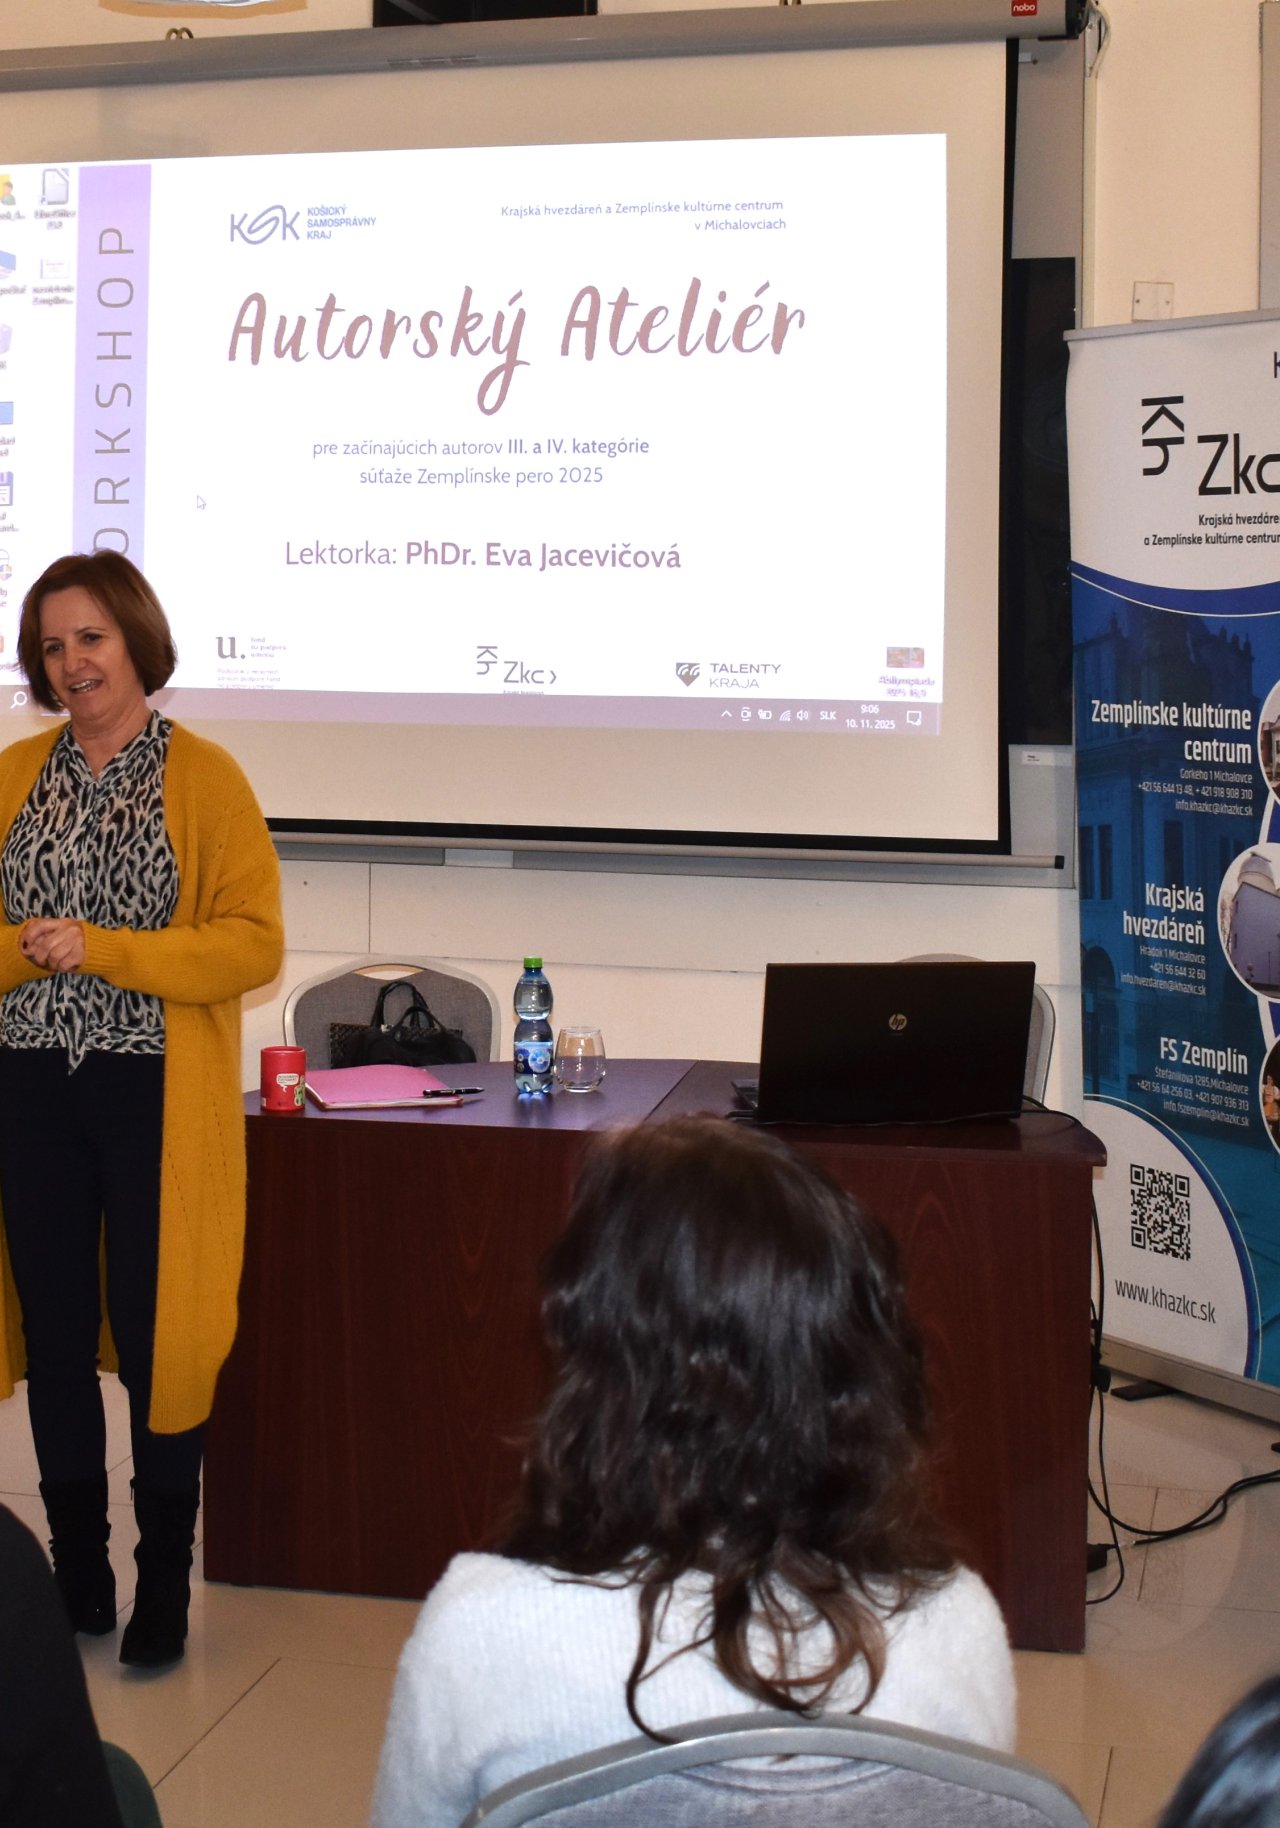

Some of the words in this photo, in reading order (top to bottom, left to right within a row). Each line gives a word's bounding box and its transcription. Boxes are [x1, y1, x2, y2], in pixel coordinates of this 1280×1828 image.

[1012, 4, 1036, 12] nobo
[306, 205, 347, 217] KOŠICKÝ
[501, 205, 541, 219] Krajská
[544, 203, 602, 216] hvezdáreň
[605, 206, 612, 215] a
[615, 201, 681, 216] Zemplínske
[683, 200, 733, 213] kultúrne
[734, 200, 784, 211] centrum
[306, 215, 377, 229] SAMOSPRÁVNY
[694, 222, 701, 231] v
[704, 218, 787, 231] Michalovciach
[306, 230, 332, 241] KRAJ
[228, 285, 531, 416] Autorský
[561, 276, 806, 361] Ateliér
[92, 227, 135, 554] ORKSHOP
[312, 444, 338, 459] pre
[343, 438, 438, 461] začínajúcich
[441, 441, 503, 456] autorov
[508, 438, 528, 456] III.
[533, 443, 542, 455] a
[547, 438, 568, 455] IV.
[572, 437, 650, 459] kategórie
[1197, 432, 1280, 496] Zkc
[360, 467, 413, 485] súťaže
[417, 466, 511, 489] Zemplínske
[516, 471, 554, 488] pero
[559, 467, 604, 484] 2025
[1198, 512, 1233, 528] Krajská
[1235, 511, 1280, 525] hvezdáre
[1143, 537, 1150, 546] a
[1151, 532, 1203, 548] Zemplínske
[1205, 532, 1244, 545] kultúrne
[285, 541, 397, 566] Lektorka:
[405, 540, 477, 567] PhDr.
[485, 542, 532, 568] Eva
[539, 542, 682, 571] Jacevičová
[709, 663, 782, 675] TALENTY
[709, 677, 760, 689] KRAJA
[819, 709, 837, 721] SLK
[860, 704, 880, 714] 9:06
[1091, 699, 1179, 729] Zemplínske
[1182, 702, 1252, 730] kultúrne
[845, 719, 858, 729] 10.
[860, 719, 874, 729] 11.
[874, 719, 896, 730] 2025
[1184, 738, 1252, 764] centrum
[1214, 770, 1253, 784] Michalovce
[1153, 782, 1161, 793] 56
[1145, 882, 1205, 913] Krajská
[1122, 910, 1205, 946] hvezdáreň
[889, 1013, 908, 1031] hp
[1160, 1036, 1178, 1062] FS
[1181, 1040, 1248, 1075] Zemplín
[1114, 1279, 1217, 1324] www.khazkc.sk
